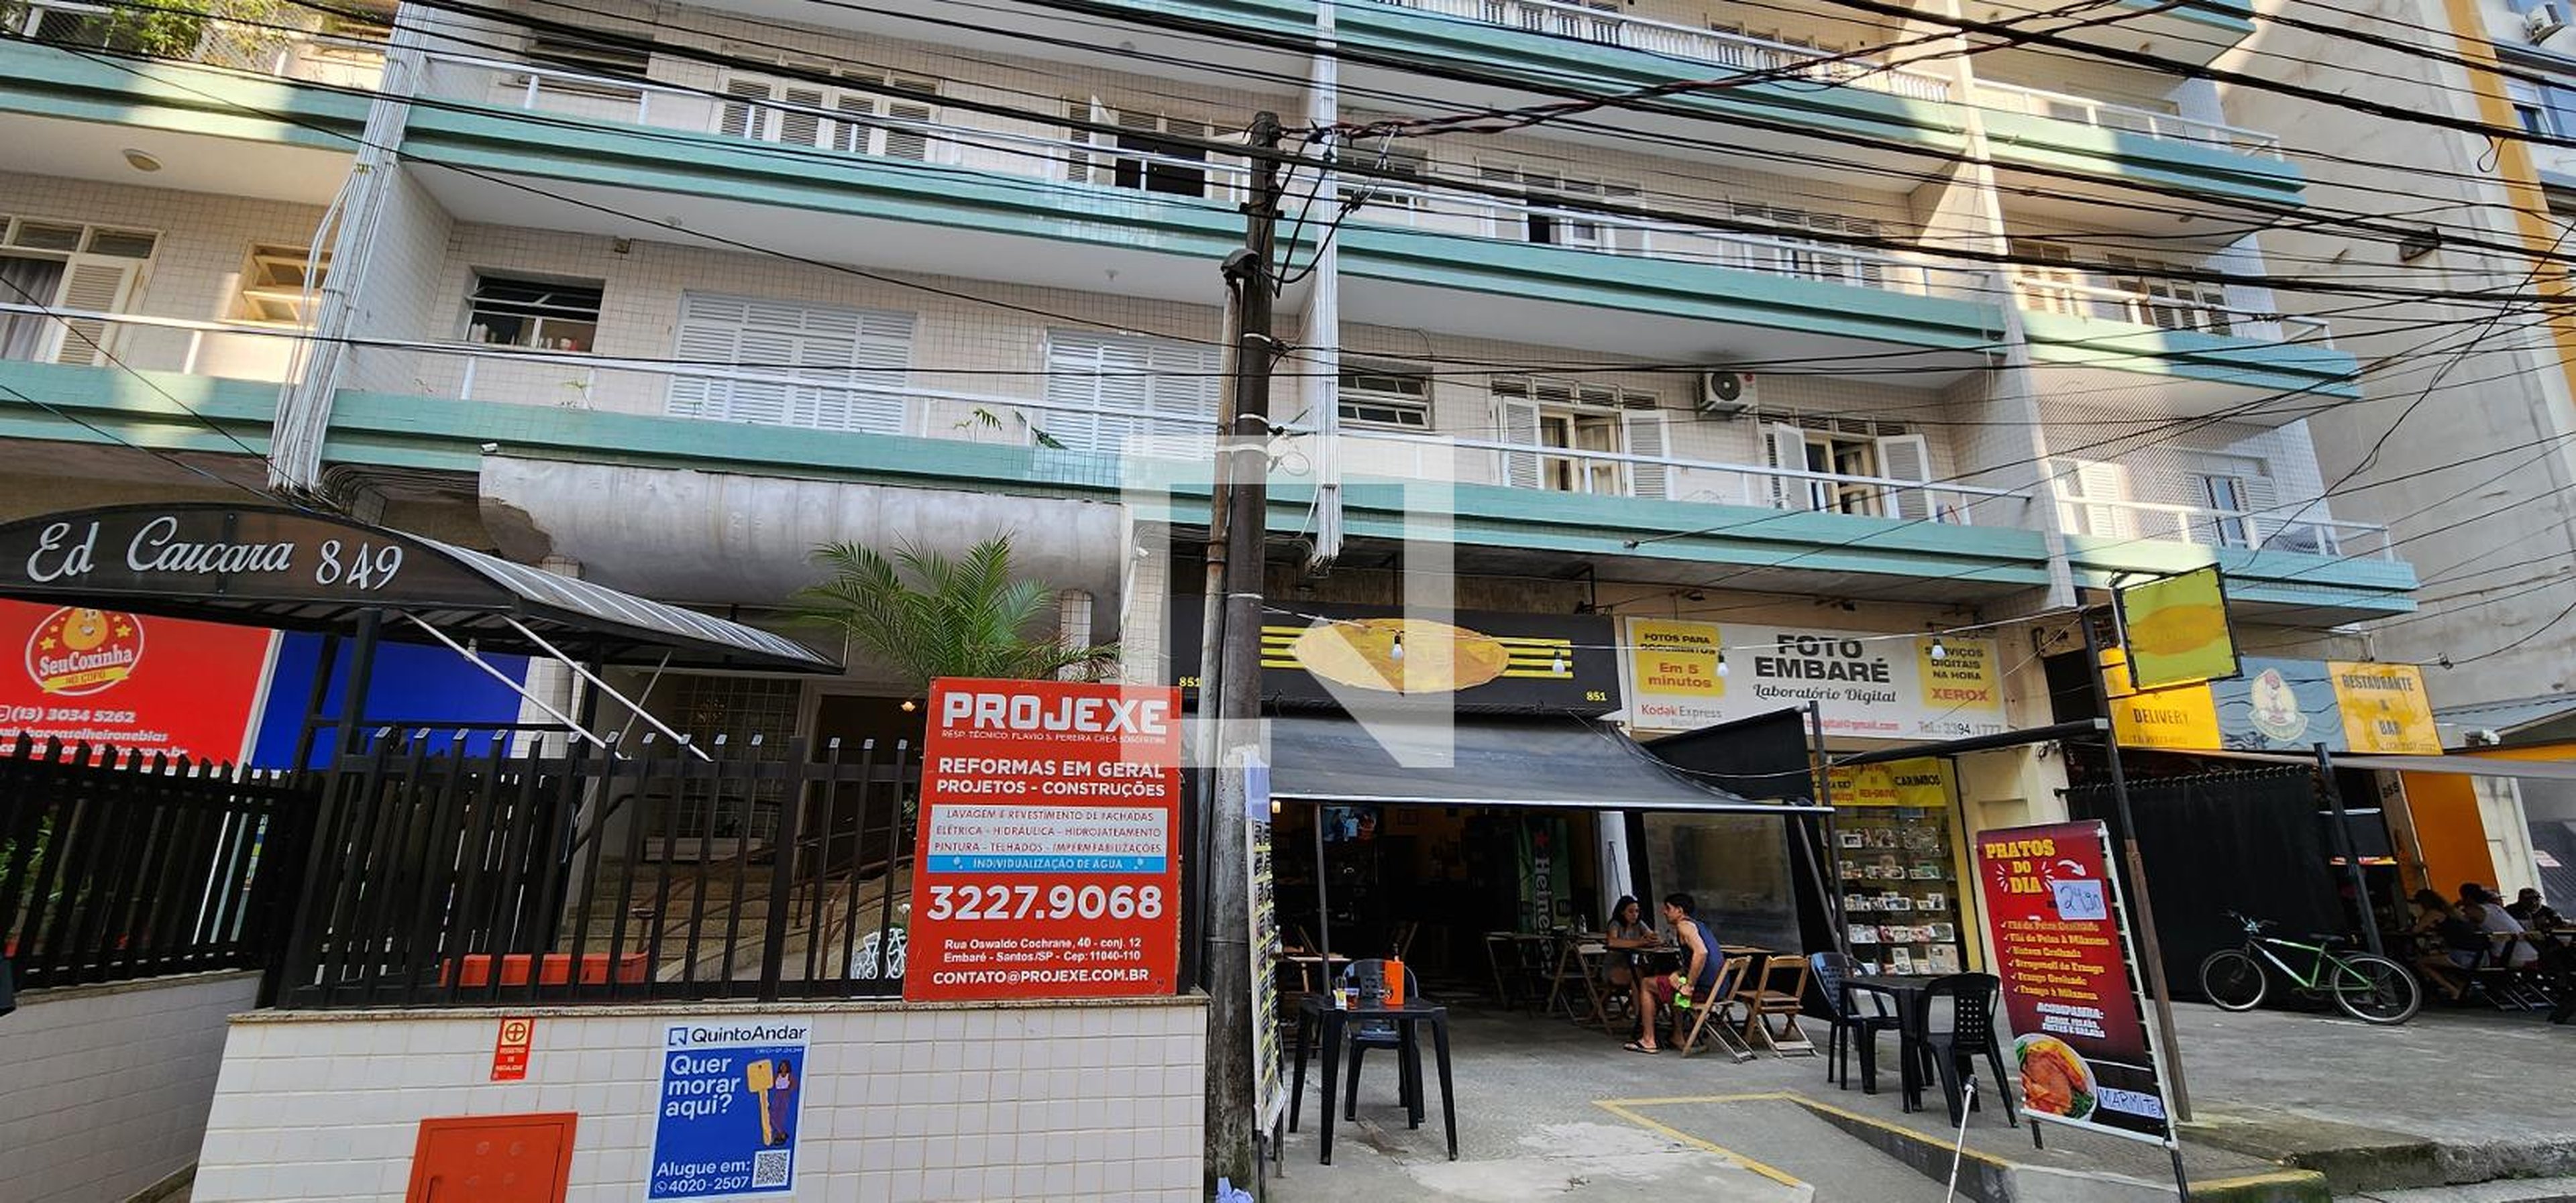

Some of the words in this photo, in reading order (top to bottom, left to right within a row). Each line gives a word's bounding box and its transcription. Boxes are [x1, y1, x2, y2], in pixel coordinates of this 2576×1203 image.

[27, 521, 100, 582] Ed
[315, 540, 402, 590] 849
[1644, 633, 1680, 643] FOTOS
[1682, 635, 1711, 644] PARA
[1778, 634, 1863, 658] FOTO
[39, 644, 133, 677] SeuCoxinha
[1659, 663, 1682, 674] Em
[1688, 664, 1699, 675] 5
[1931, 659, 1981, 669] DIGITAIS
[1754, 656, 1890, 683] EMBARÉ
[1951, 672, 1982, 680] HORA
[1178, 677, 1201, 687] 851
[1648, 675, 1713, 689] minutos
[1586, 691, 1607, 701] 851
[1753, 683, 1841, 701] Laboratório
[1844, 688, 1896, 705] Digital
[1931, 687, 1989, 702] XEROX
[11, 706, 44, 722] (13)
[46, 708, 91, 722] 3034
[93, 709, 136, 723] 5262
[942, 691, 1169, 735] PROJEXE
[1641, 704, 1677, 716] Kodak
[1679, 705, 1723, 719] Express
[939, 757, 1057, 776] REFORMAS
[1063, 760, 1091, 777] EM
[1097, 762, 1165, 779] GERAL
[936, 779, 1026, 794] PROJETOS
[1042, 781, 1166, 798] CONSTRUÇÕES
[947, 809, 996, 819] LAVAGEM
[1008, 810, 1083, 820] REVESTIMENTO
[1086, 811, 1097, 821] DE
[1101, 811, 1154, 821] FACHADAS
[1065, 826, 1161, 838] HIDROJATEAMENTO
[935, 842, 979, 852] PINTURA
[990, 843, 1043, 853] TELHADOS
[1984, 839, 2055, 860] PRATOS
[973, 856, 1074, 870] INDIVIDUALIZAÇÃO
[1077, 858, 1090, 869] DE
[2012, 860, 2032, 874] DO
[2010, 876, 2043, 894] DIA
[927, 884, 1163, 921] 3227.9068
[945, 939, 967, 950] Rua
[969, 938, 1018, 949] Oswaldo
[1130, 937, 1141, 948] 12
[944, 952, 987, 963] Embaré
[933, 968, 1150, 985] CONTATO@PROJEXE.COM.BR
[692, 1025, 807, 1043] QuintoAndar
[671, 1055, 732, 1076] Quer
[668, 1077, 741, 1095] morar
[665, 1093, 733, 1120] aqui?
[656, 1161, 717, 1178] Alugue
[720, 1160, 751, 1173] em:
[669, 1176, 750, 1194] 4020-2507
